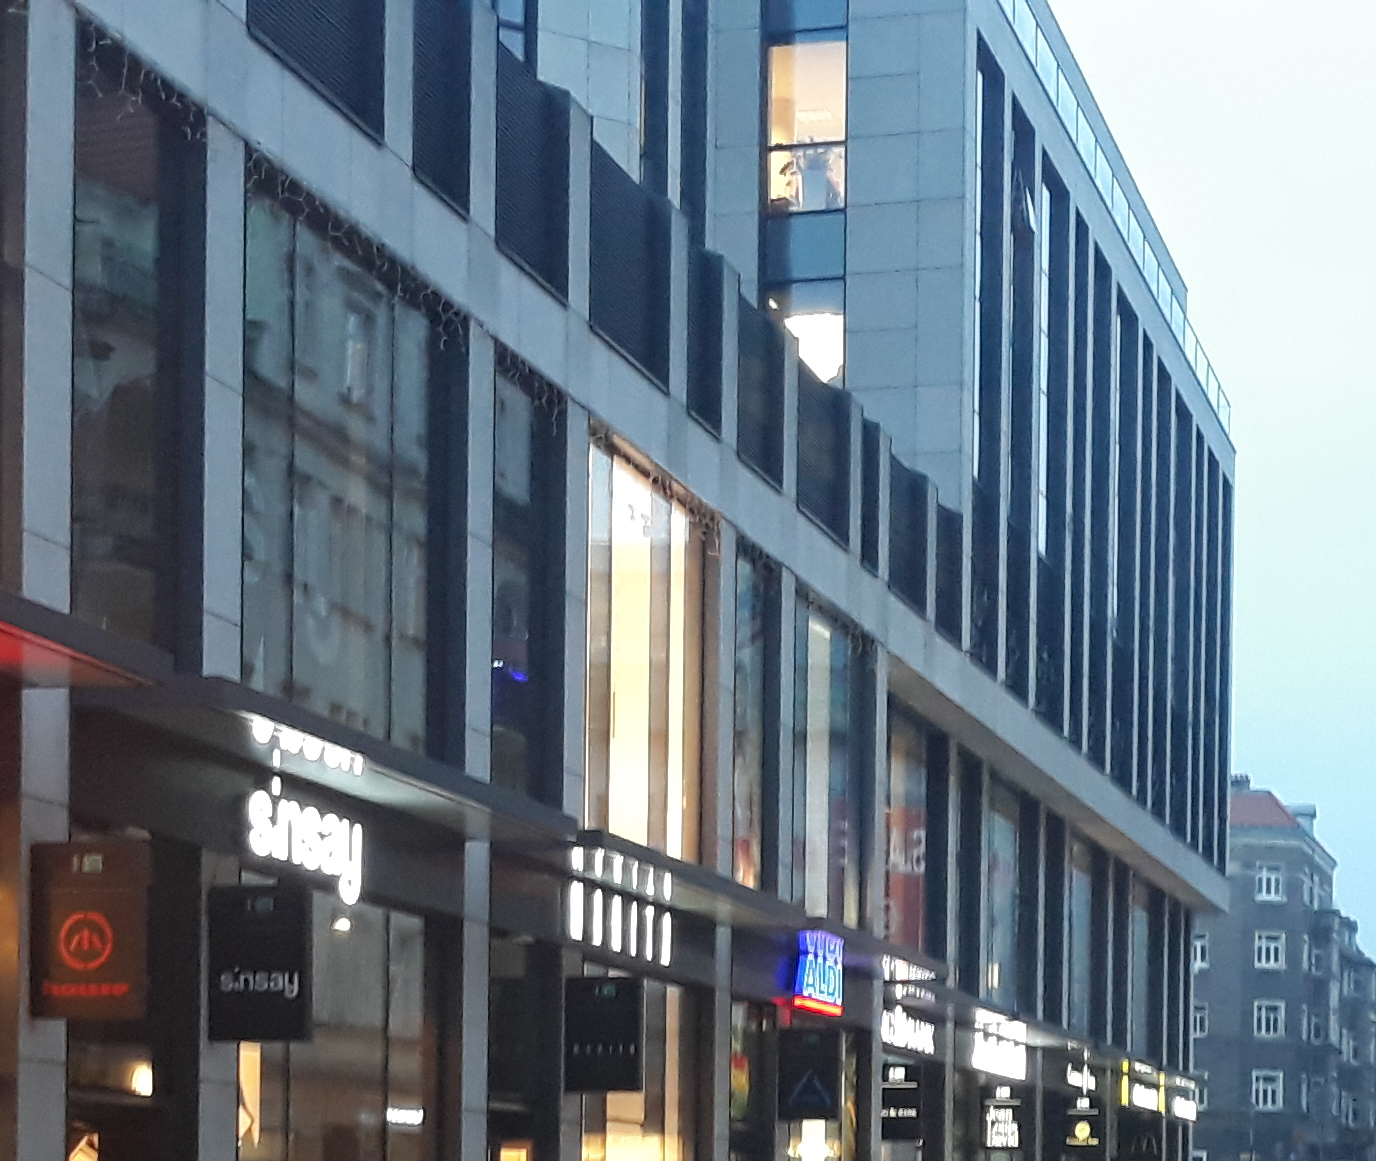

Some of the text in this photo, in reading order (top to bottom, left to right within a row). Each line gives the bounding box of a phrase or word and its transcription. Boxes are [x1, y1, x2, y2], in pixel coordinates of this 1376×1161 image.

[246, 774, 364, 906] sinsay
[219, 965, 300, 1000] sinsay
[804, 955, 843, 1002] ALDI
